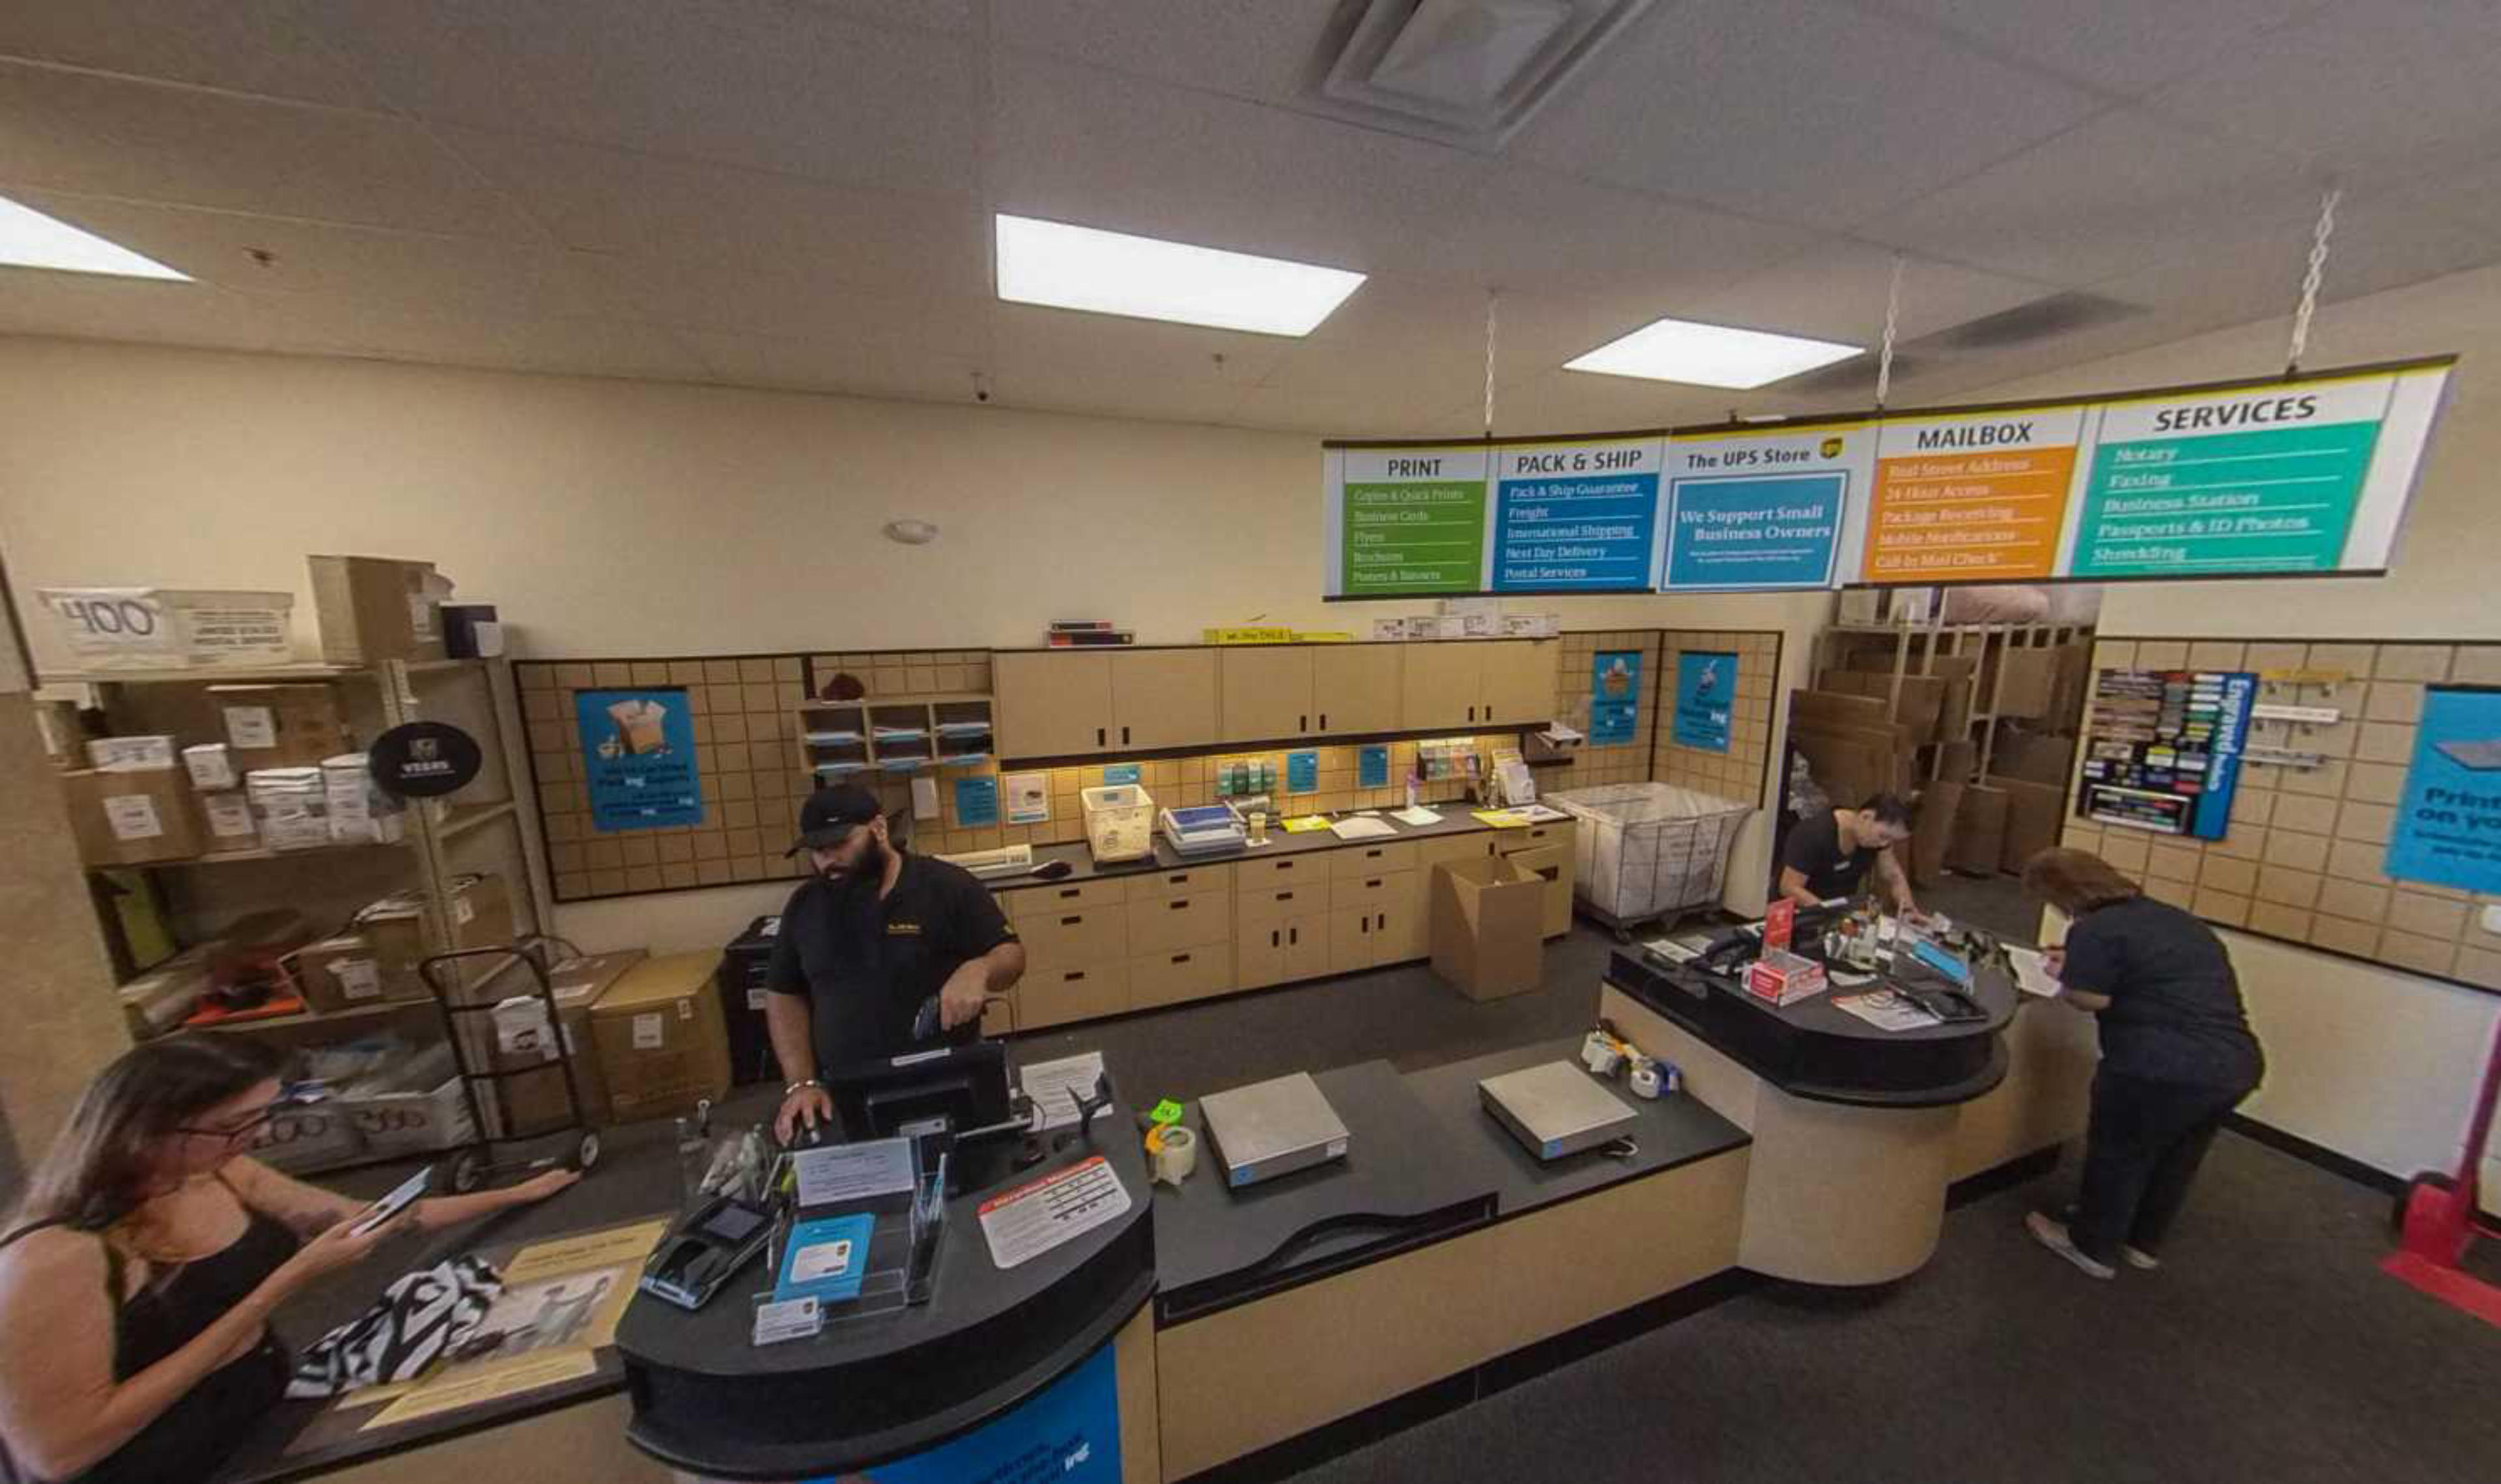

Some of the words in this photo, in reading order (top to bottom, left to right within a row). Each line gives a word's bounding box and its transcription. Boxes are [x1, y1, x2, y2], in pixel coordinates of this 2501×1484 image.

[2153, 396, 2317, 431] SERVICES
[1918, 423, 2033, 449] MAILBOX
[1518, 455, 1564, 473] PACK
[1573, 453, 1587, 470] &
[1594, 450, 1642, 469] SHIP
[1688, 455, 1717, 469] The
[1723, 451, 1758, 466] UPS
[1764, 449, 1810, 464] Store
[2115, 448, 2179, 463] Notary
[1388, 459, 1441, 477] PRINT
[2110, 473, 2172, 488] Faxing
[1510, 487, 1534, 499] Pack
[1548, 484, 1574, 499] Ship
[1577, 483, 1639, 496] Guarantee
[2104, 499, 2183, 513] Business
[2188, 494, 2260, 510] Station
[1508, 508, 1549, 520] Freight
[1680, 511, 1705, 524] We
[1708, 508, 1773, 525] Support
[1776, 505, 1824, 520] Small
[1507, 526, 1579, 539] International
[1580, 525, 1635, 540] Shipping
[1695, 526, 1762, 541] Business
[1764, 524, 1831, 539] Owners
[2098, 524, 2188, 540] Passports
[2189, 521, 2203, 535] &
[2209, 519, 2232, 533] ID
[2235, 517, 2310, 532] Photos
[1534, 548, 1556, 560] Day
[1558, 546, 1607, 560] Delivery
[61, 599, 154, 635] 400
